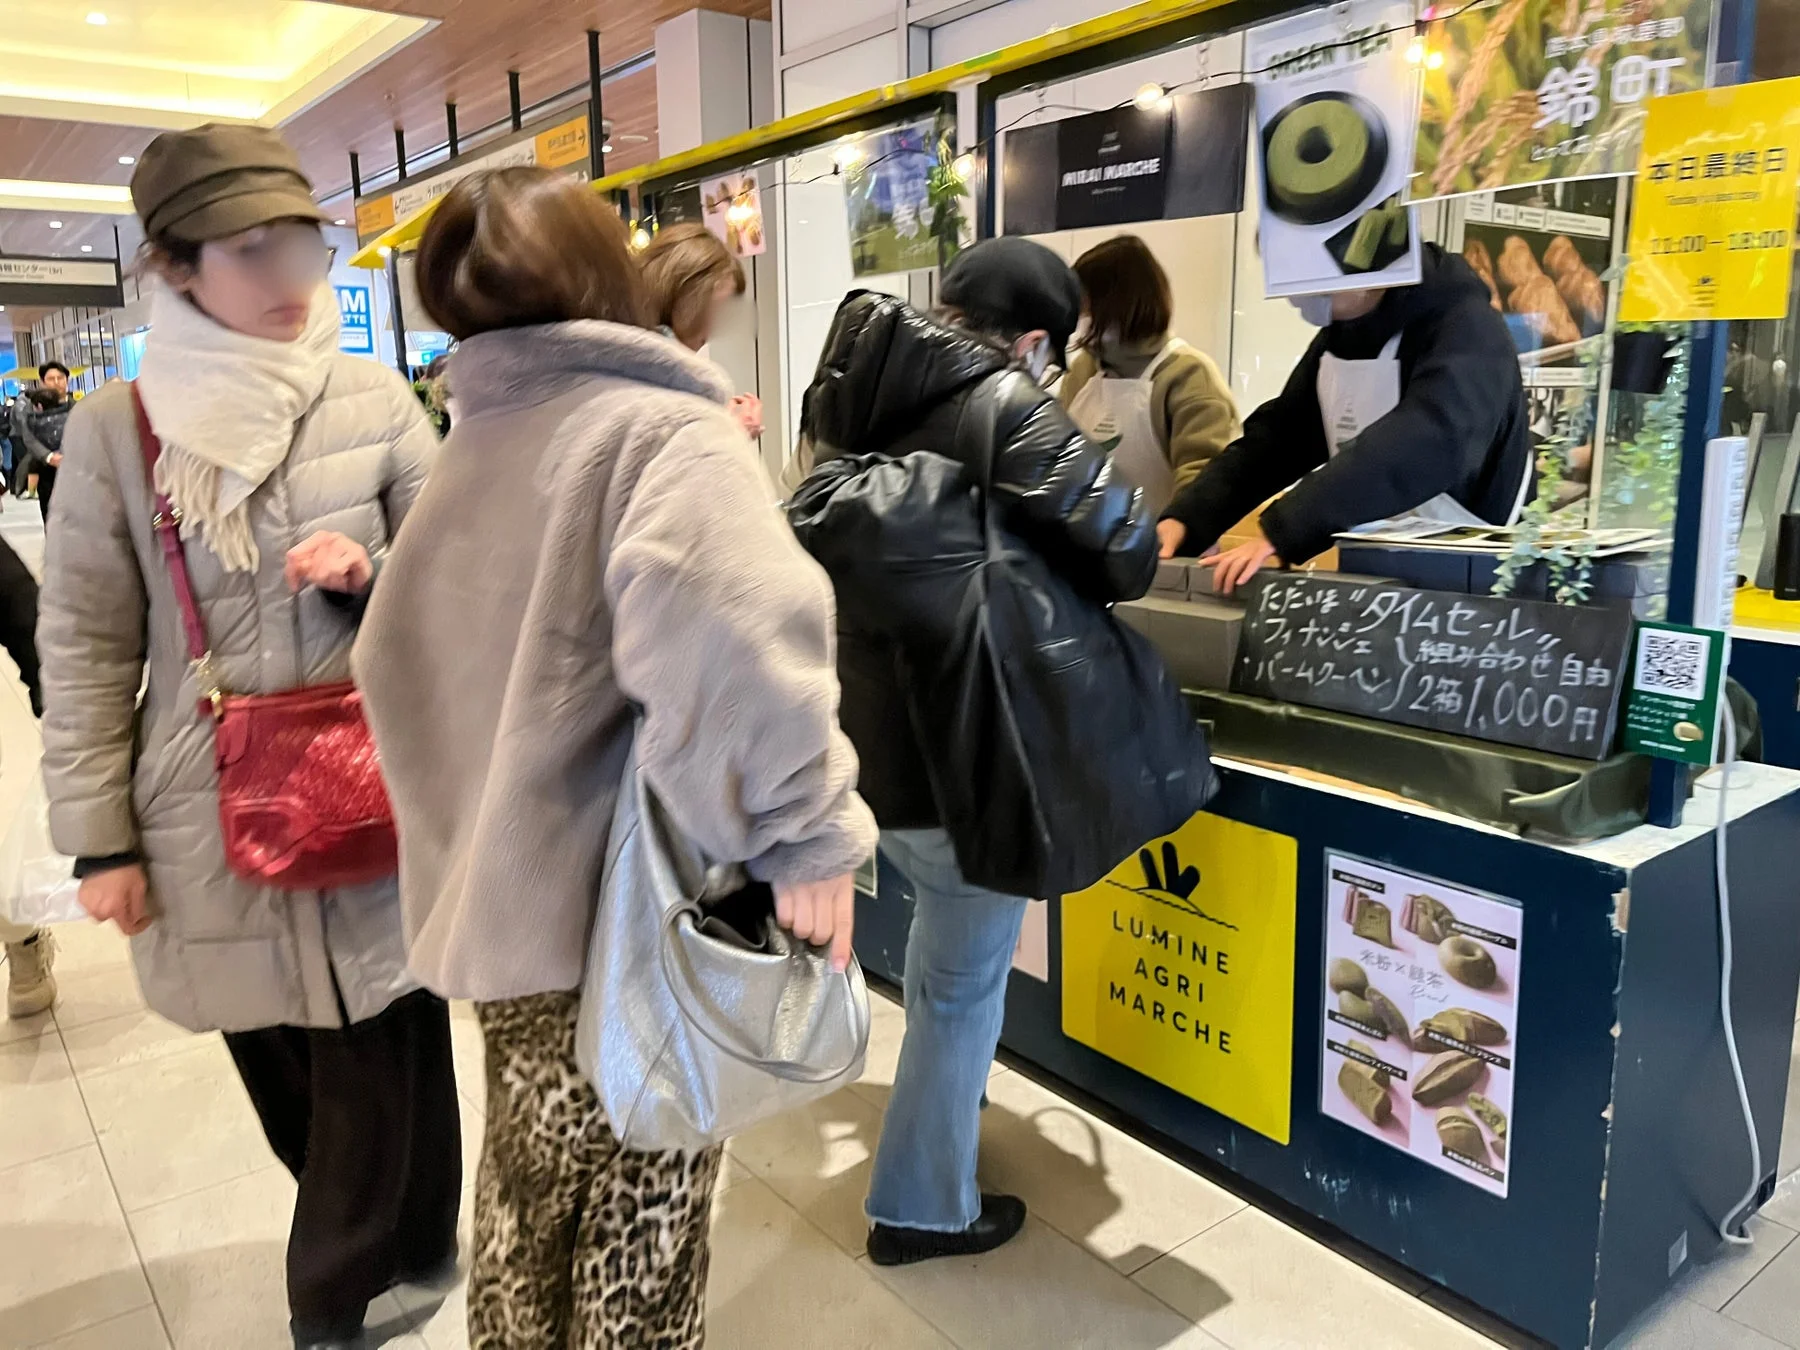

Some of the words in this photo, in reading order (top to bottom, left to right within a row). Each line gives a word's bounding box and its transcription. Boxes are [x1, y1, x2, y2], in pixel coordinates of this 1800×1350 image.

[1532, 54, 1687, 129] 錦町
[1103, 157, 1160, 182] MARCHE
[1648, 147, 1787, 184] 本日最終日
[1259, 579, 1340, 615] ただいま
[1113, 910, 1229, 975] LUMINE
[1134, 957, 1204, 1003] AGRI
[1110, 981, 1231, 1054] MARCHE
